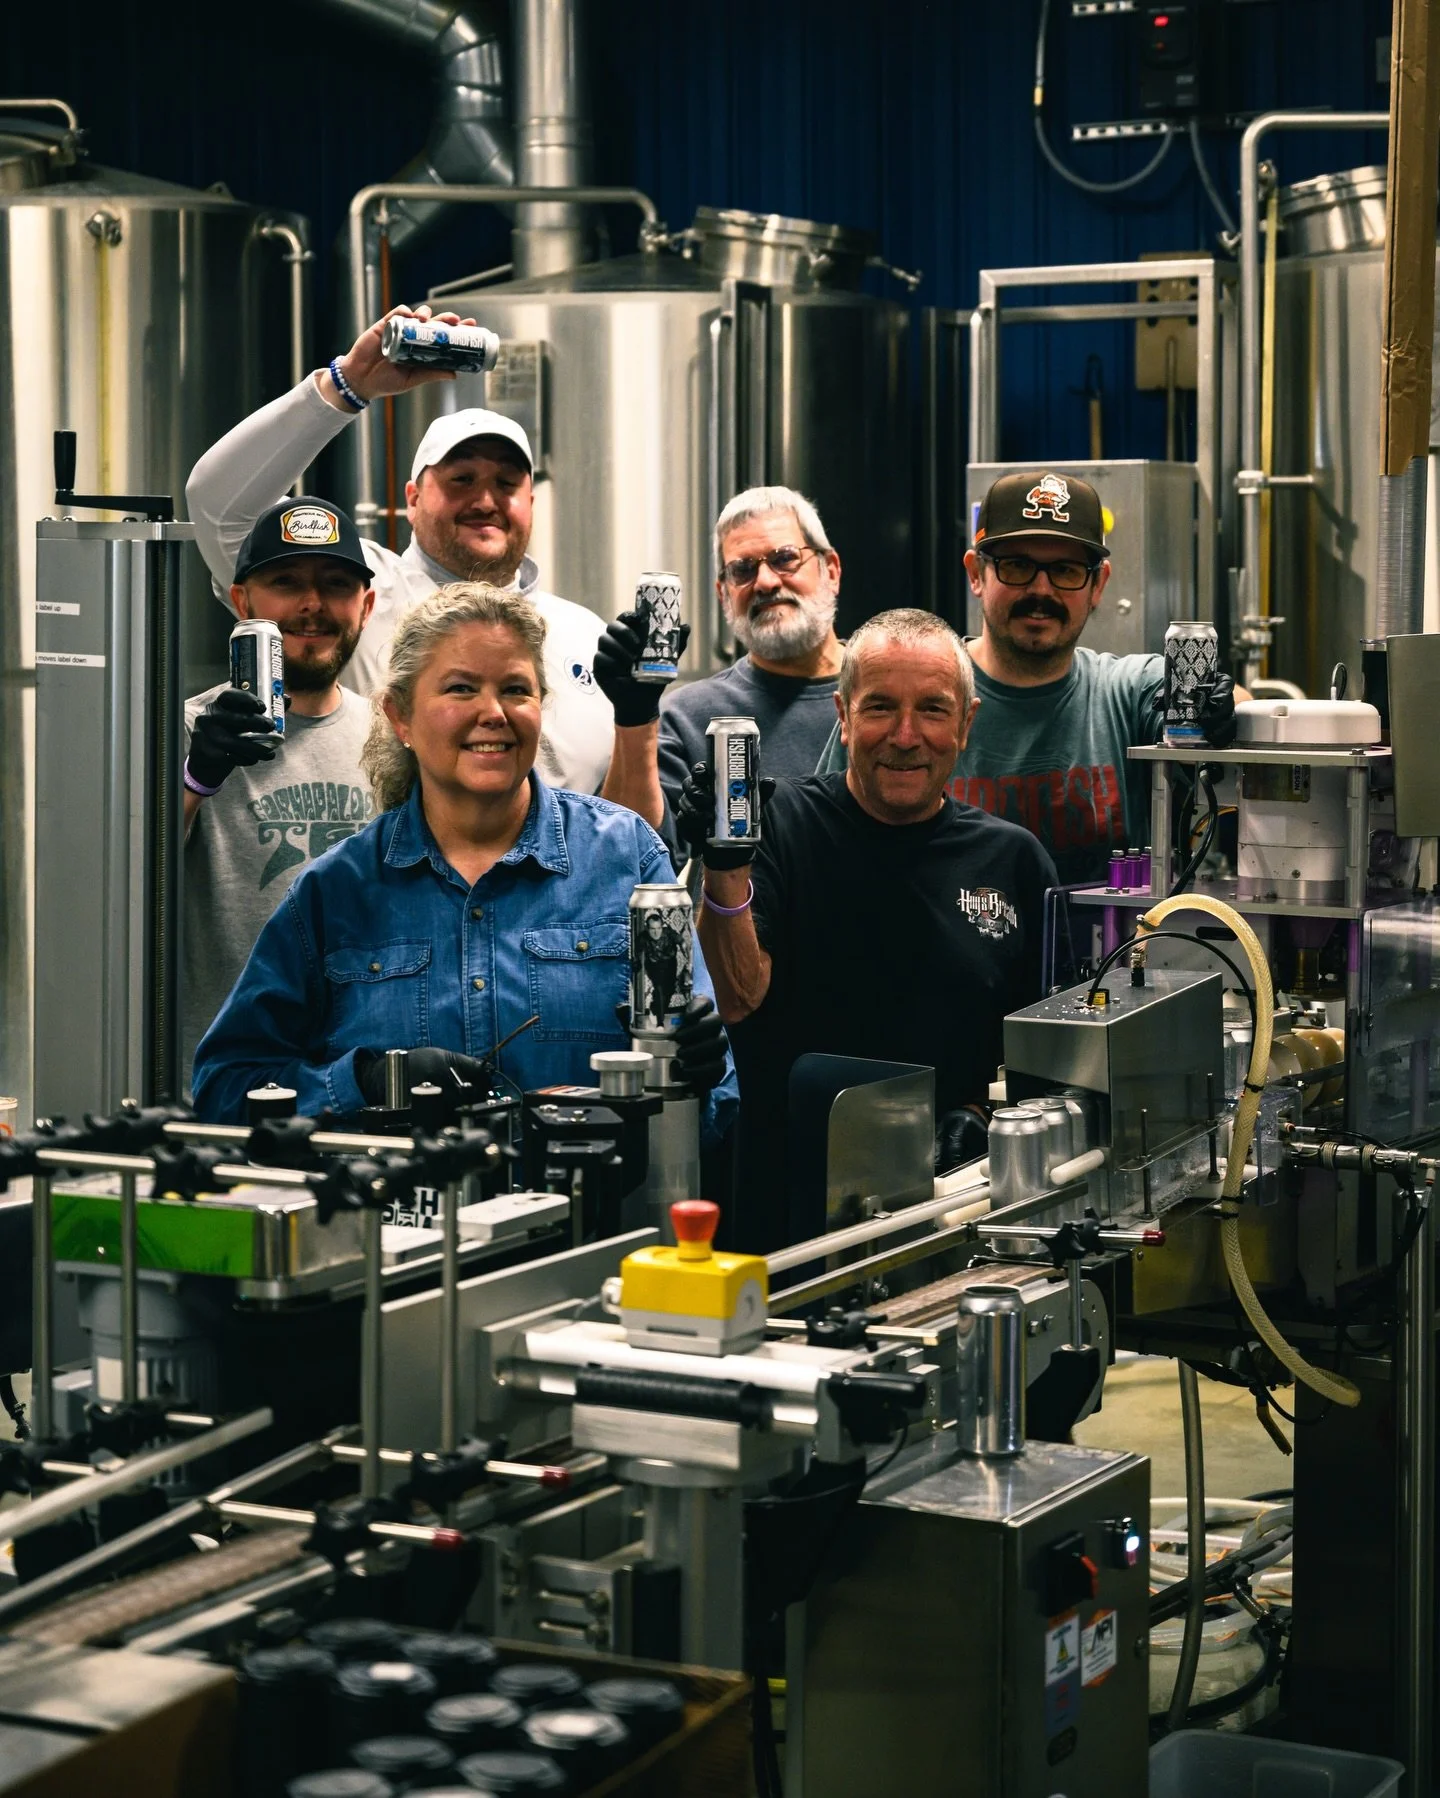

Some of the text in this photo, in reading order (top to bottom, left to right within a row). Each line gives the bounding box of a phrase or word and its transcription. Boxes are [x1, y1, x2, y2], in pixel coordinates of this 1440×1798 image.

[289, 520, 330, 534] Birdfish
[57, 655, 71, 663] label
[72, 656, 87, 664] down
[271, 639, 283, 680] BIRDFISH
[729, 738, 747, 820] DUDE BIRDFISH
